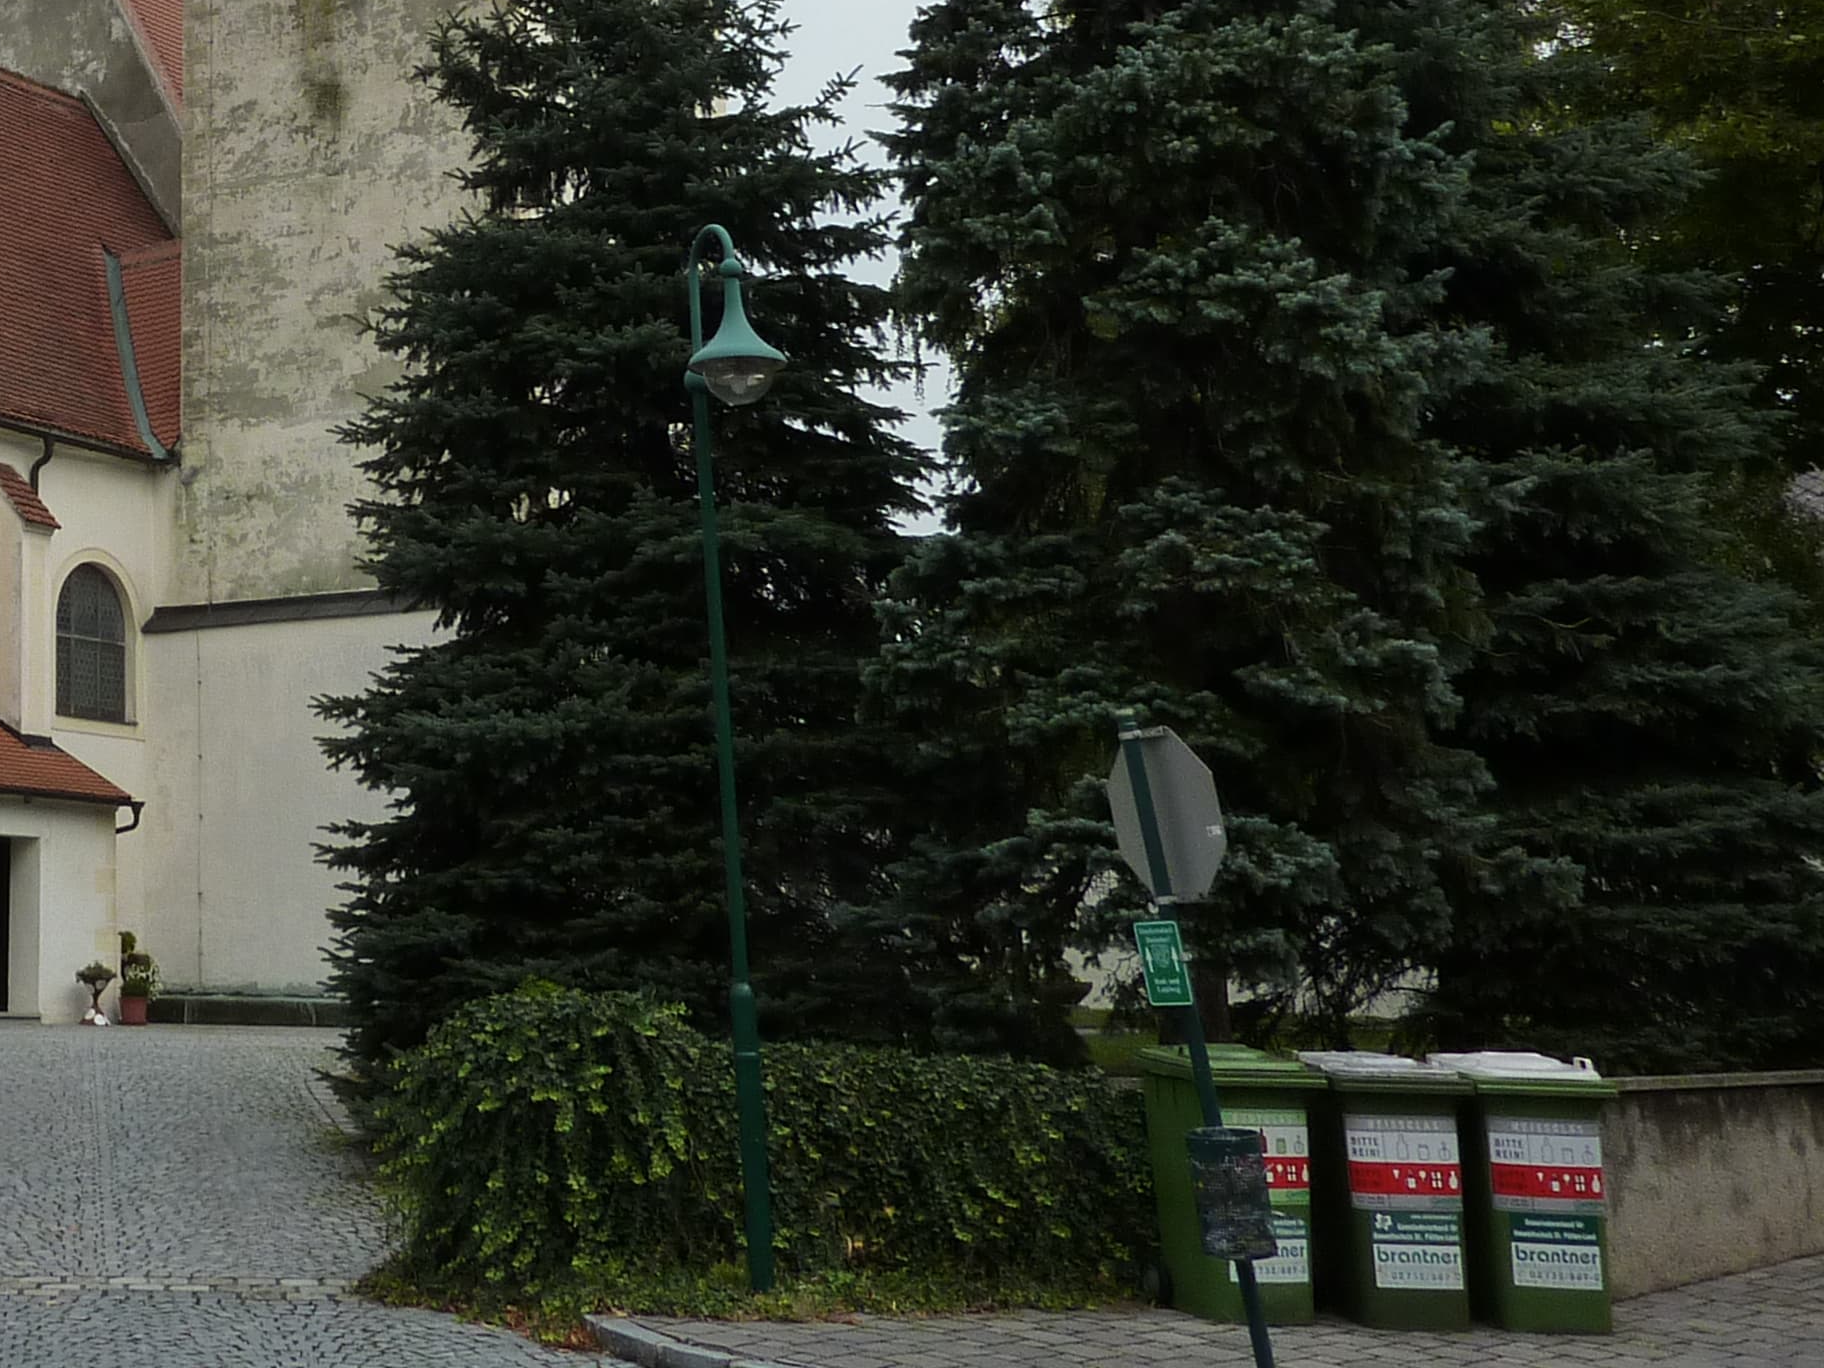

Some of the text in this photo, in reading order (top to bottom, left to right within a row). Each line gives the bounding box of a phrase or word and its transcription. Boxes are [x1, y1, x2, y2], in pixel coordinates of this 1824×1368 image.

[1350, 1136, 1379, 1146] BITTE
[1494, 1137, 1523, 1148] BITTE
[1377, 1245, 1458, 1264] brantner
[1515, 1244, 1598, 1265] brantner
